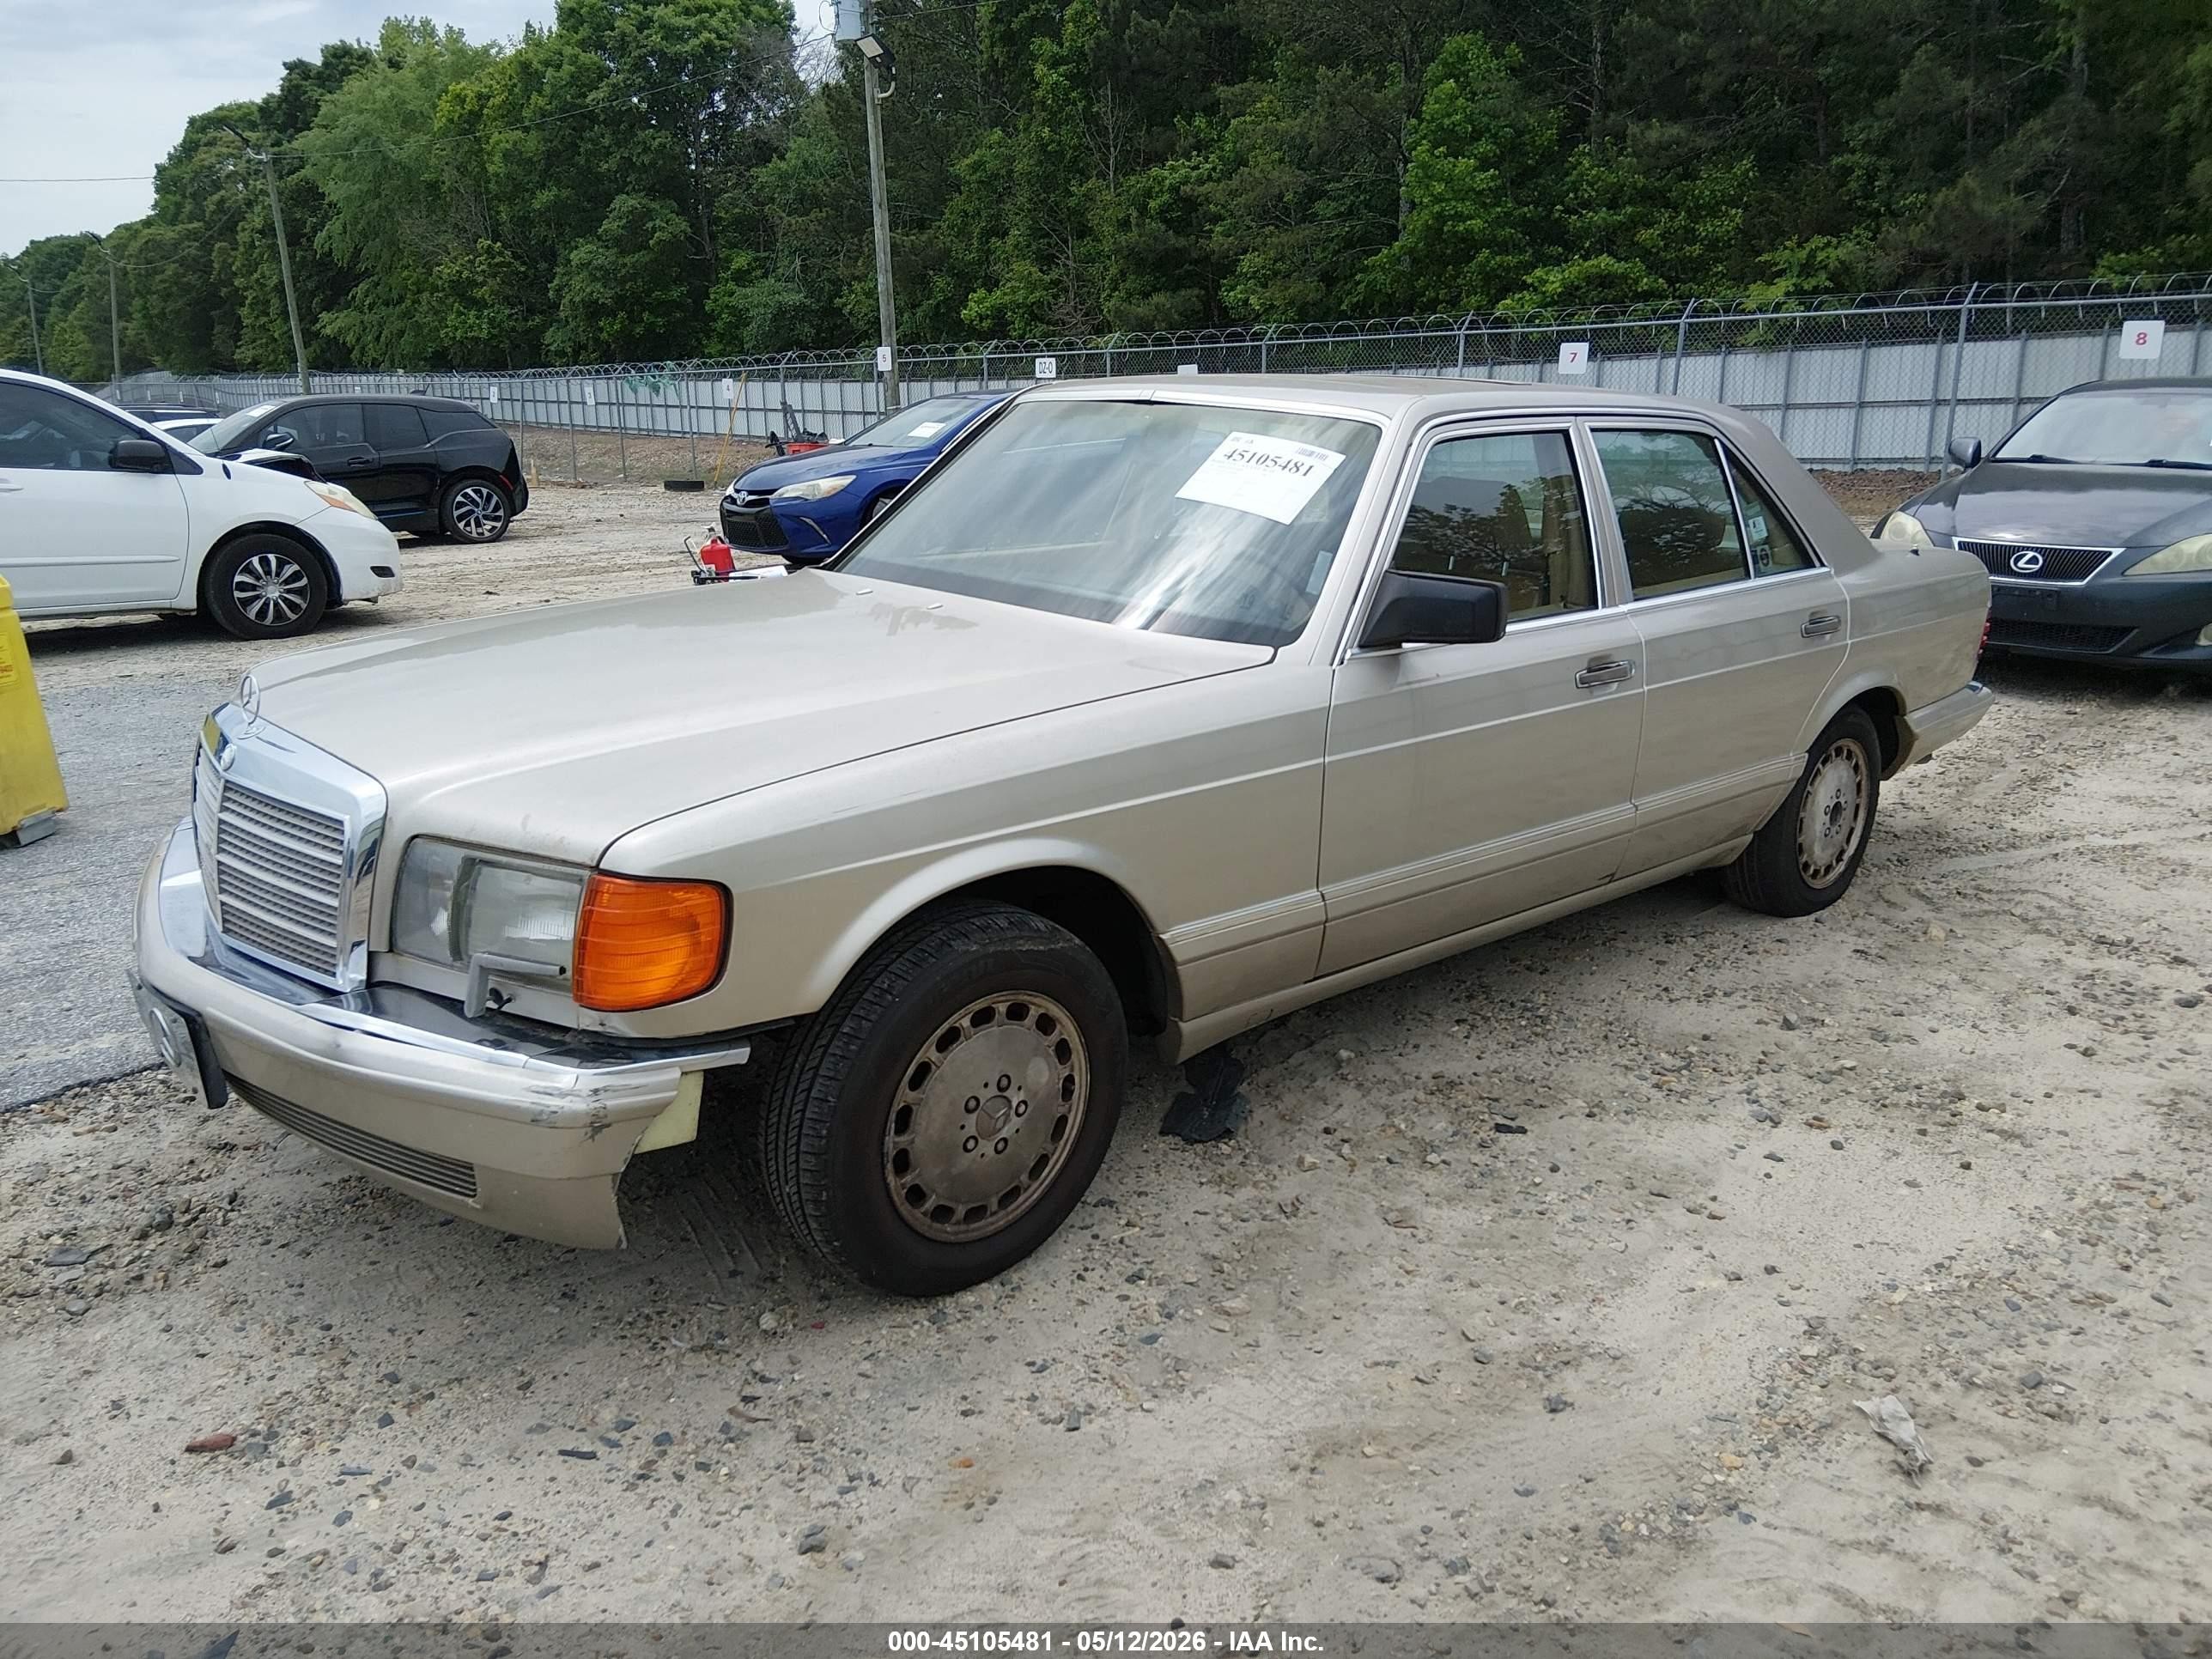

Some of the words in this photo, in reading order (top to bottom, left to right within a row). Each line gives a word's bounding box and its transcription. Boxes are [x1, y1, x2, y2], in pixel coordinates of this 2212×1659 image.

[2136, 331, 2148, 345] 8
[882, 354, 887, 362] 5
[1570, 352, 1578, 363] 7
[1224, 448, 1315, 477] 45105481
